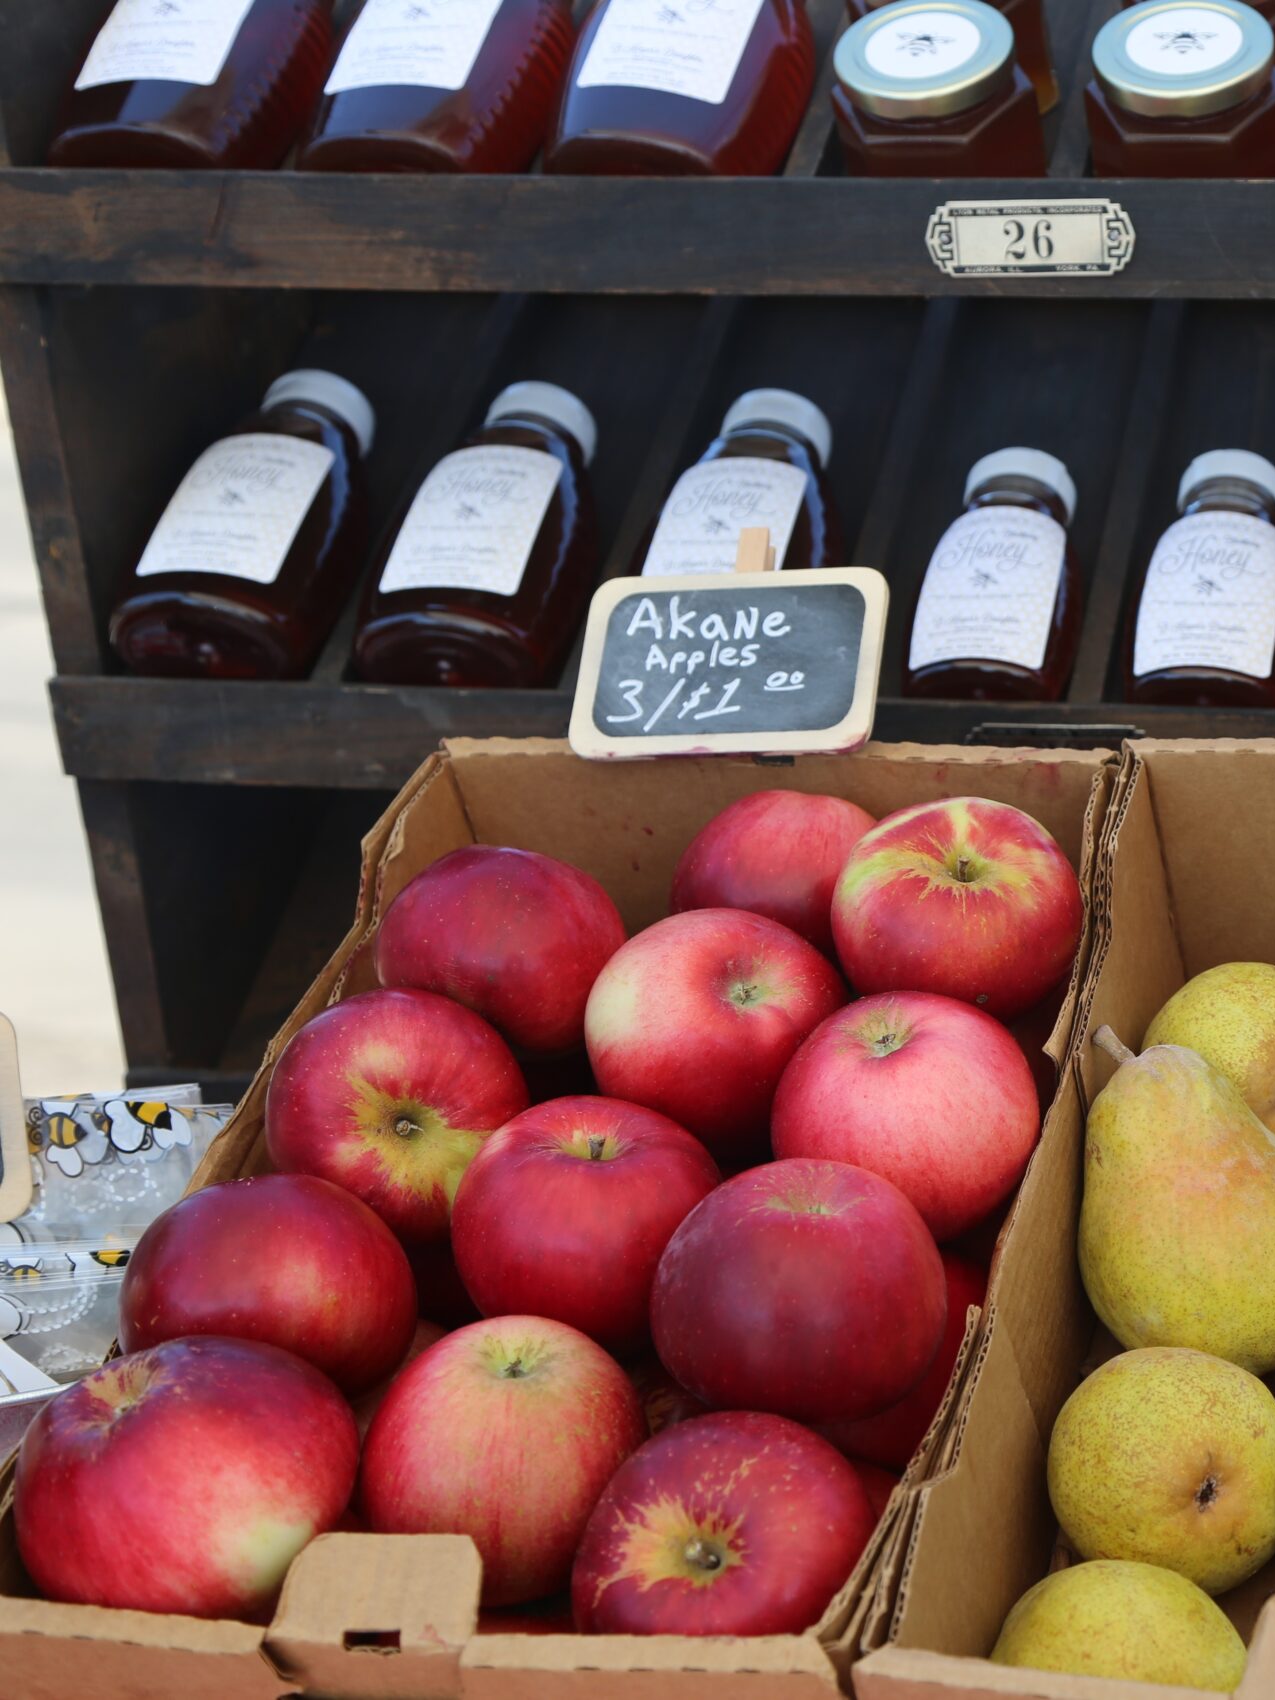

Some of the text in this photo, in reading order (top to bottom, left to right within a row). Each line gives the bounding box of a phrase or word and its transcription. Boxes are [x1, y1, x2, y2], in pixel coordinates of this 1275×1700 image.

[1003, 219, 1054, 261] 26
[671, 478, 777, 520] Honey
[936, 528, 1043, 572] Honey
[1158, 534, 1265, 580] Honey
[645, 640, 761, 675] Apples
